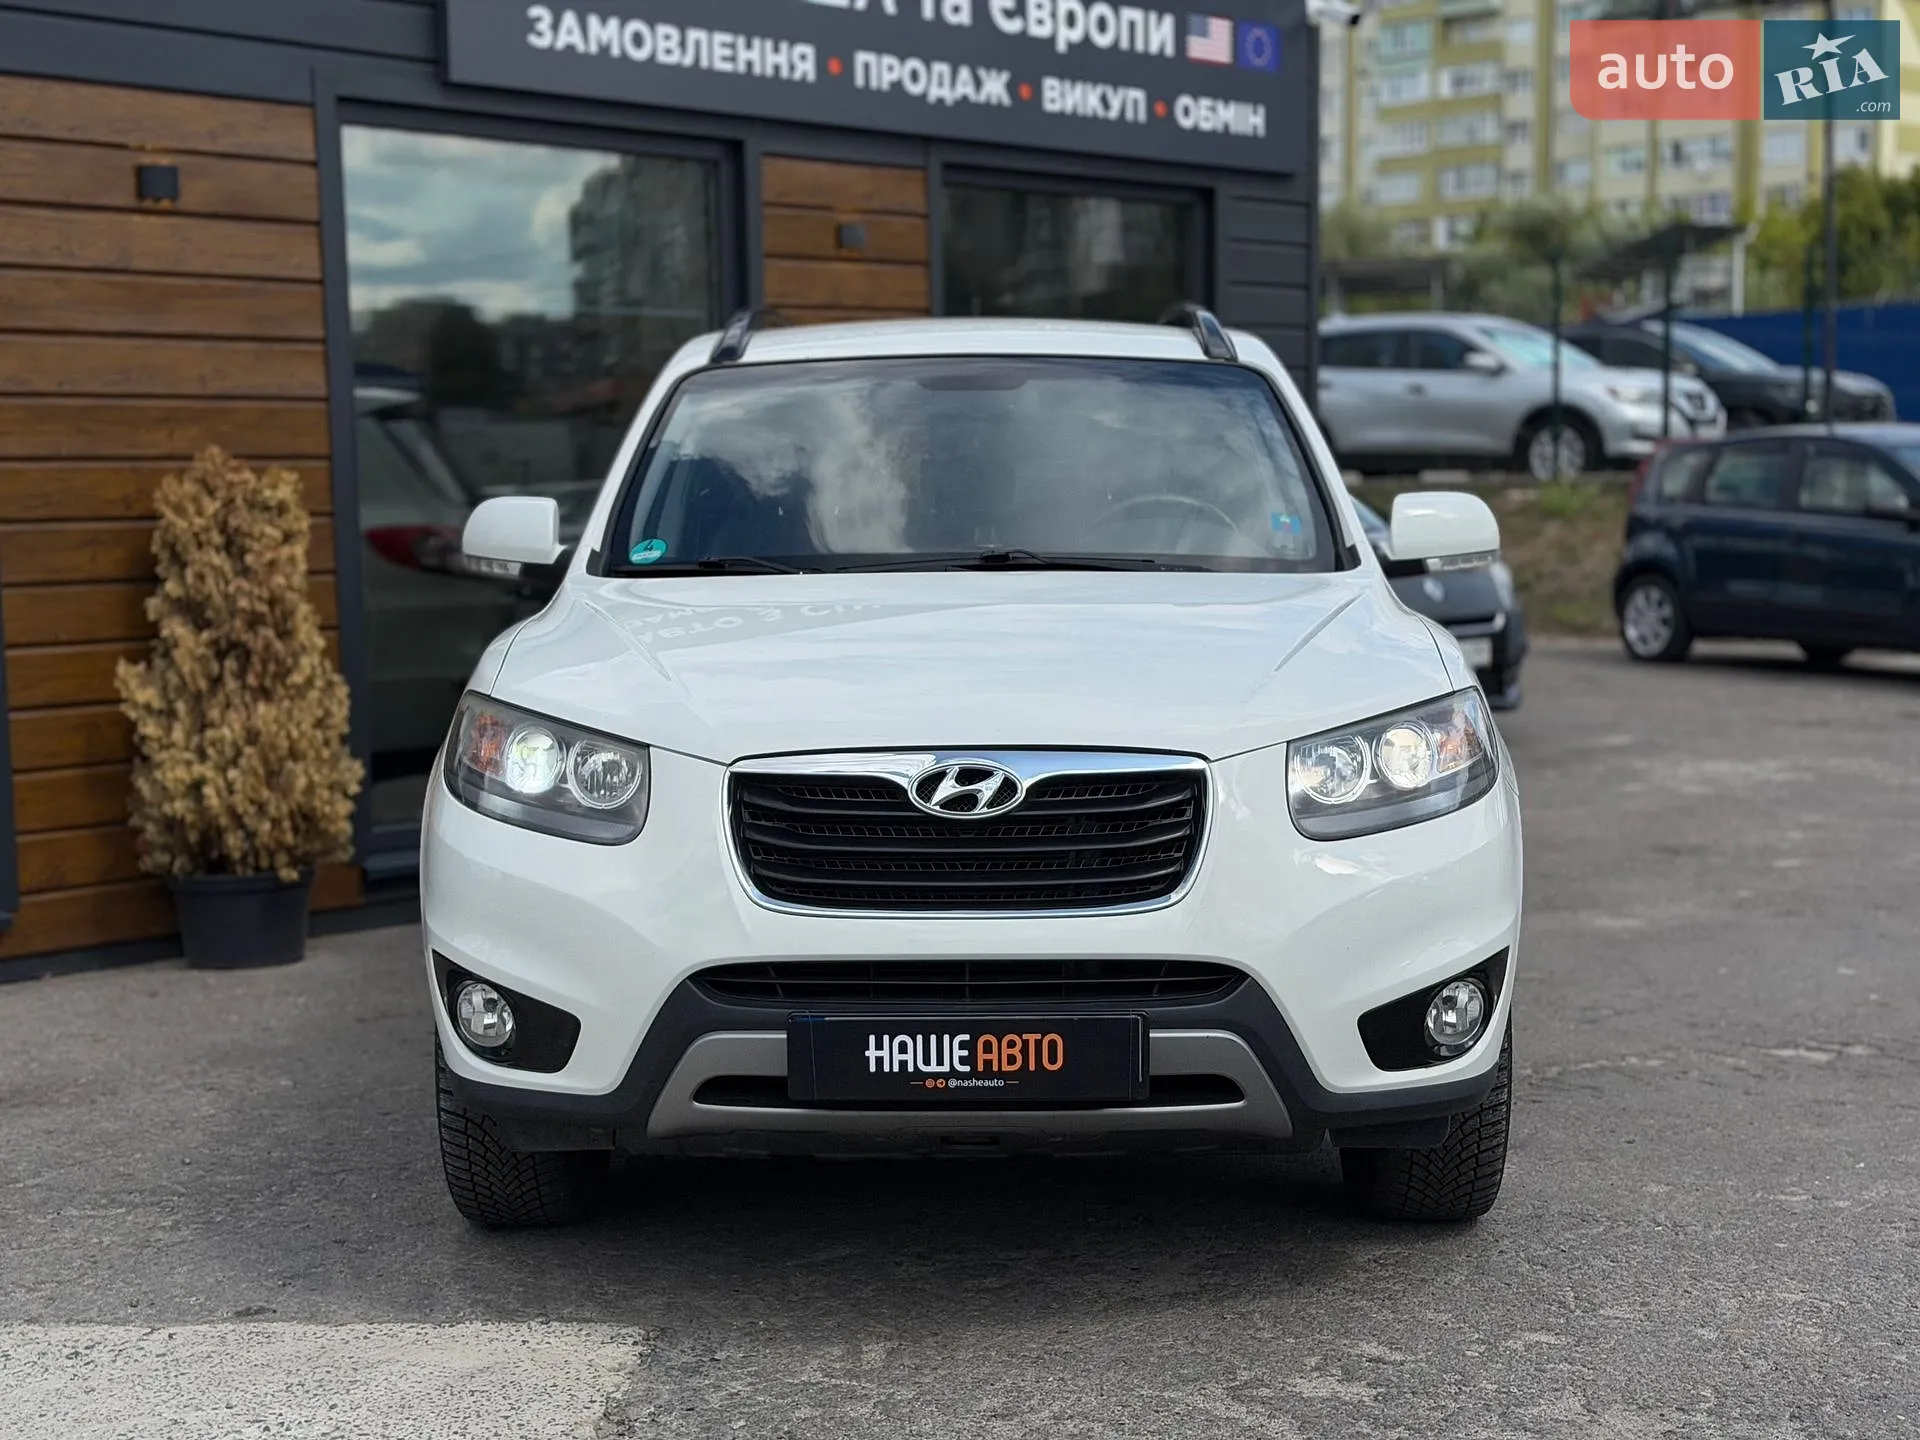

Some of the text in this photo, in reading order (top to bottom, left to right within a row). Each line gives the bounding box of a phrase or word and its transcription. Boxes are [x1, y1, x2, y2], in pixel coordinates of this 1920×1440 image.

[988, 0, 1175, 58] Європи
[526, 4, 1266, 138] ЗАМОВЛЕННЯ ПРОДАЖ ВИКУП ОБМІН
[865, 1033, 1063, 1072] НАШЕ АВТО
[948, 1077, 1005, 1088] @nasheauto
